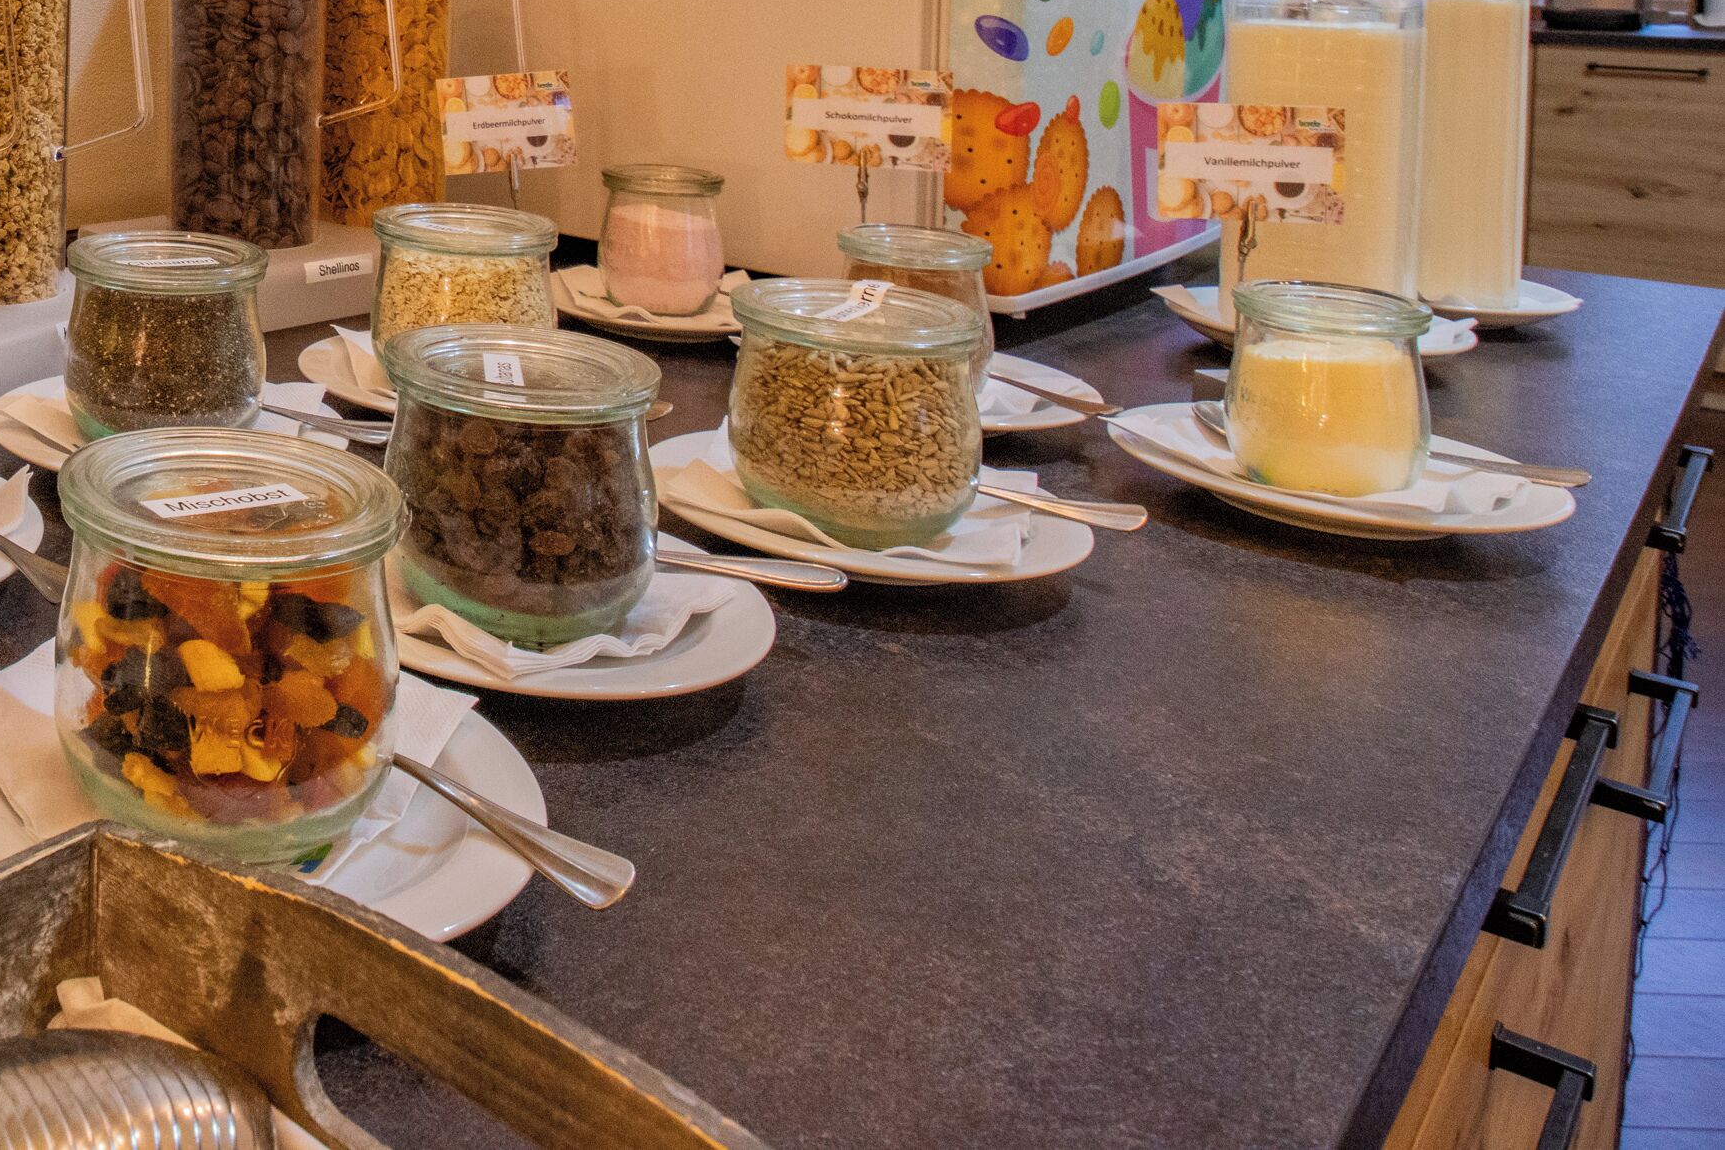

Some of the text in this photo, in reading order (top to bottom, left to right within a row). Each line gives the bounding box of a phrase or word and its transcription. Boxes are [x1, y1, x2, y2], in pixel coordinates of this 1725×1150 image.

[472, 117, 546, 130] Erdbeermilchpulver
[825, 110, 913, 124] Schokomilchpulver
[1203, 155, 1301, 169] Vanillemilchpulver
[318, 261, 361, 277] Shellinos
[163, 488, 292, 513] Mischobst
